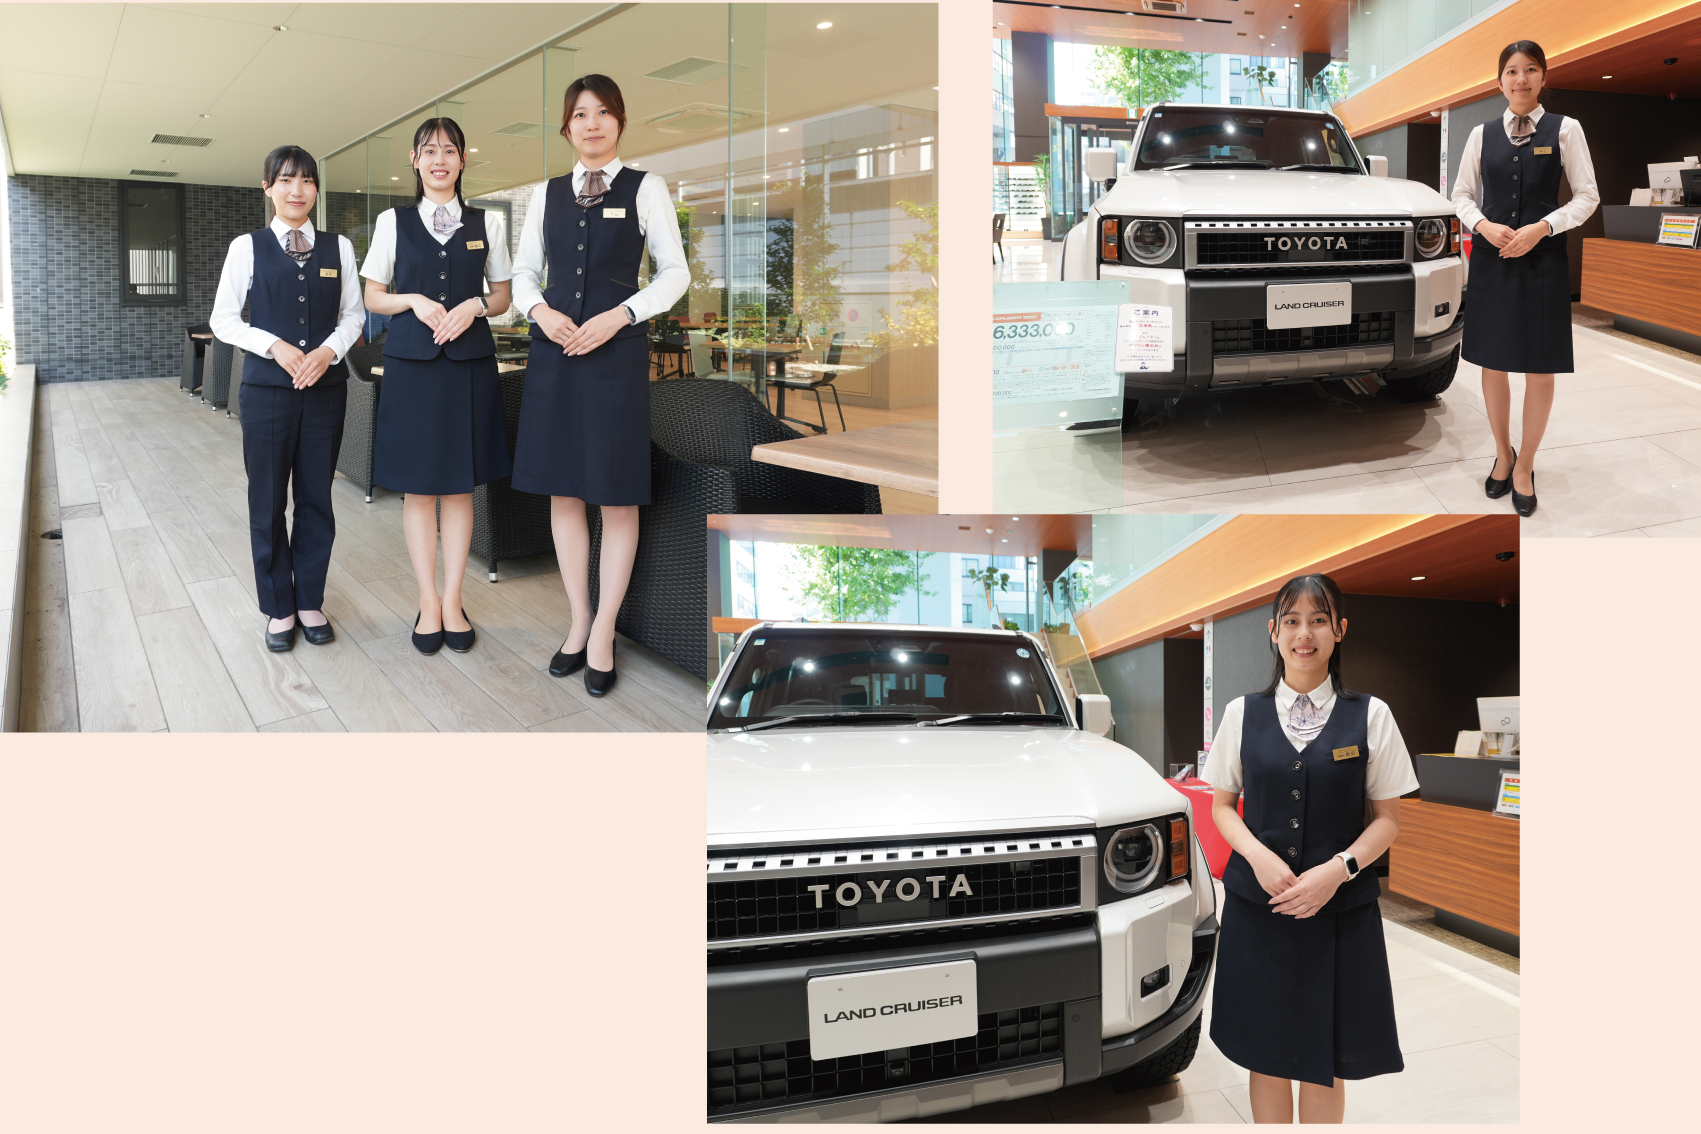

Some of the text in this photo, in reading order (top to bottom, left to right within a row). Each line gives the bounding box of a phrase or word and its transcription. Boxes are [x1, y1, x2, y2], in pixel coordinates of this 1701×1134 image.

[1263, 236, 1349, 251] TOYOTA
[1302, 301, 1345, 309] CRUISER
[807, 873, 973, 909] TOYOTA
[824, 995, 963, 1024] LAND CRUISER
